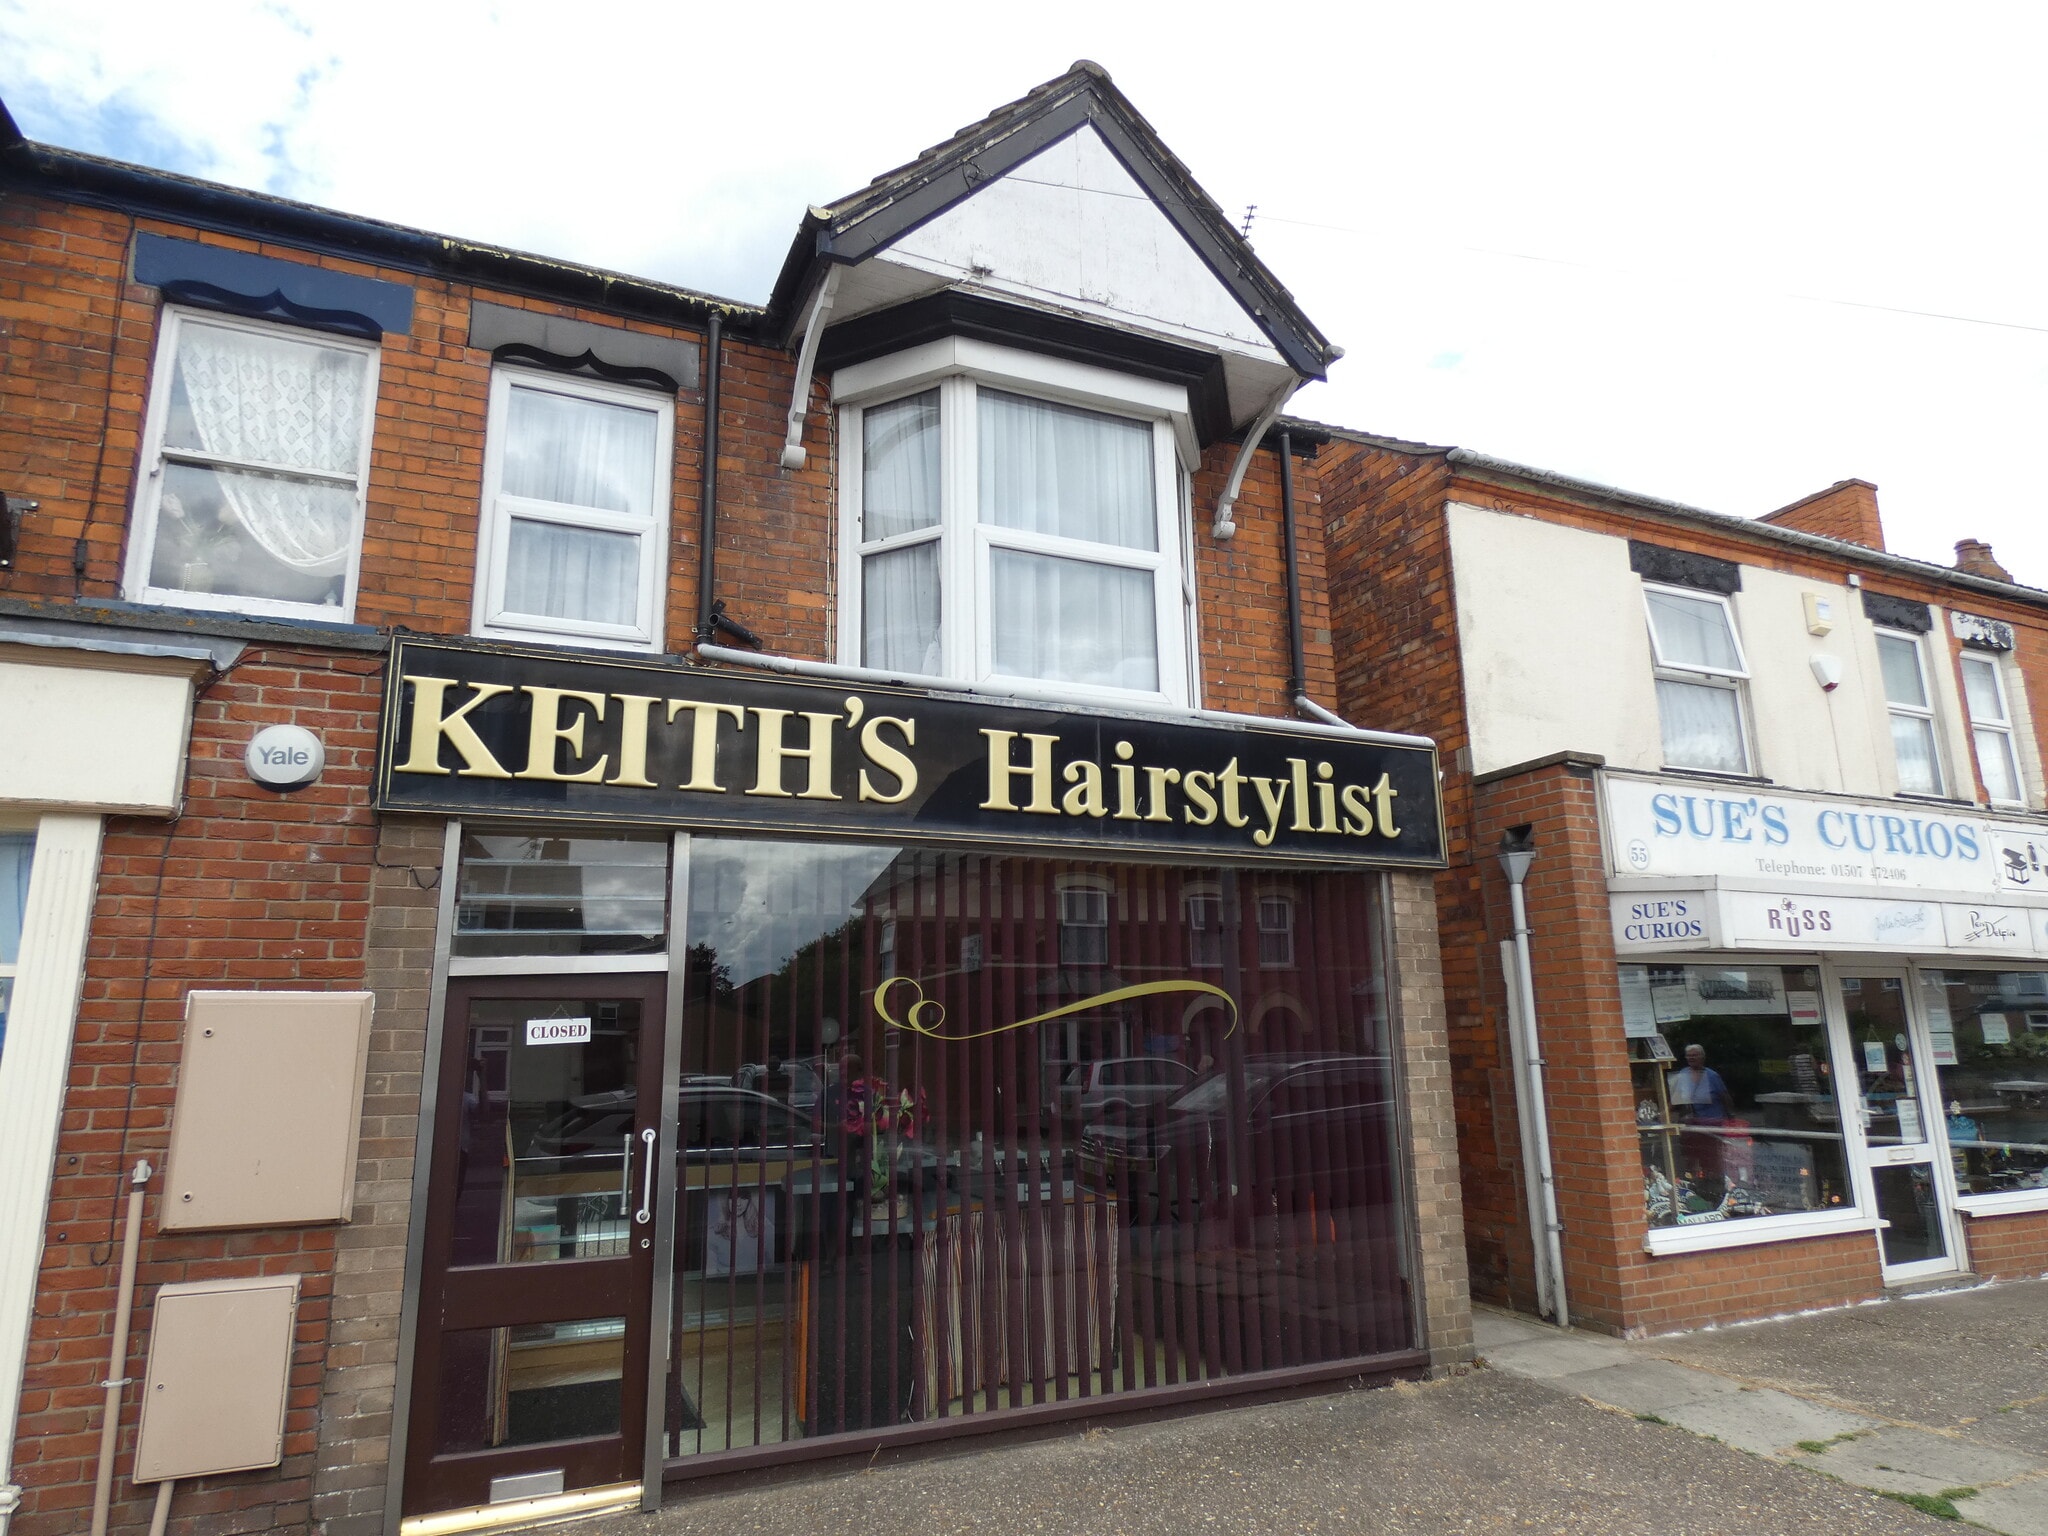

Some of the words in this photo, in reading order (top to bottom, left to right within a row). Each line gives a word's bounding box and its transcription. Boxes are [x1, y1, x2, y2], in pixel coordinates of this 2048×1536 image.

[257, 746, 309, 765] Yale
[394, 674, 919, 804] KEITH'S
[978, 728, 1402, 847] Hairstylist
[1651, 793, 1790, 846] SUE'S
[1817, 810, 1981, 862] CURIOS
[1631, 847, 1648, 863] 55
[1755, 858, 1826, 876] Telephone:
[1831, 864, 1863, 878] 01507
[1870, 866, 1907, 881] 472406
[1631, 900, 1687, 920] SUE'S
[1625, 920, 1702, 940] CURIOS
[1767, 908, 1831, 937] RUSS
[530, 1024, 588, 1039] CLOSED
